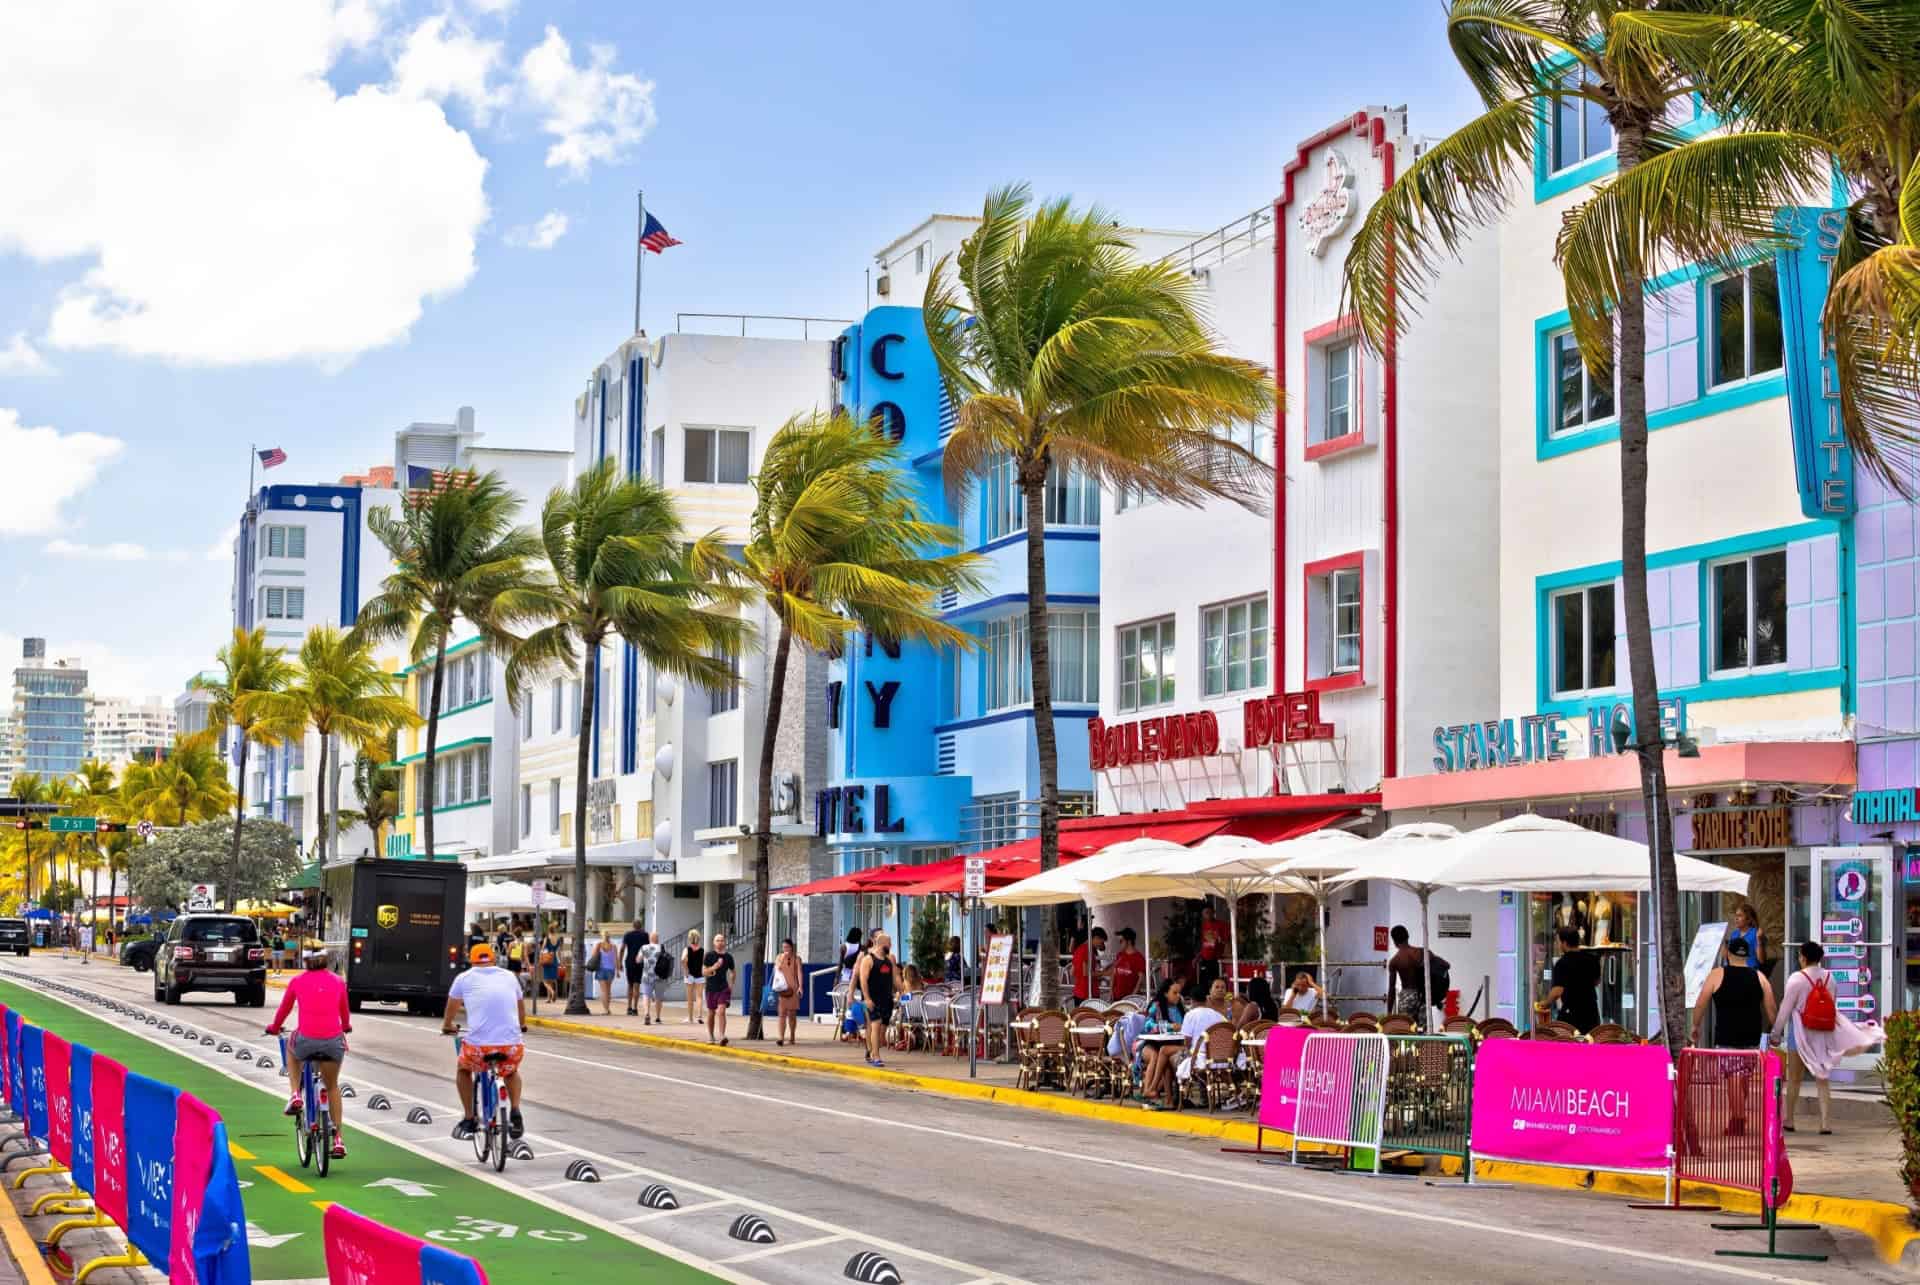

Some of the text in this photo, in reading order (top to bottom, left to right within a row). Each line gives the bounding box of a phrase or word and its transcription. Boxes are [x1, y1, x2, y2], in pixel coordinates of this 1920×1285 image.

[1088, 688, 1335, 770] BOULEVARD HOTEL
[1432, 711, 1568, 775] STARLITE
[63, 820, 69, 829] 7
[1692, 806, 1792, 849] STARLITE HOTEL
[650, 862, 673, 873] CVS
